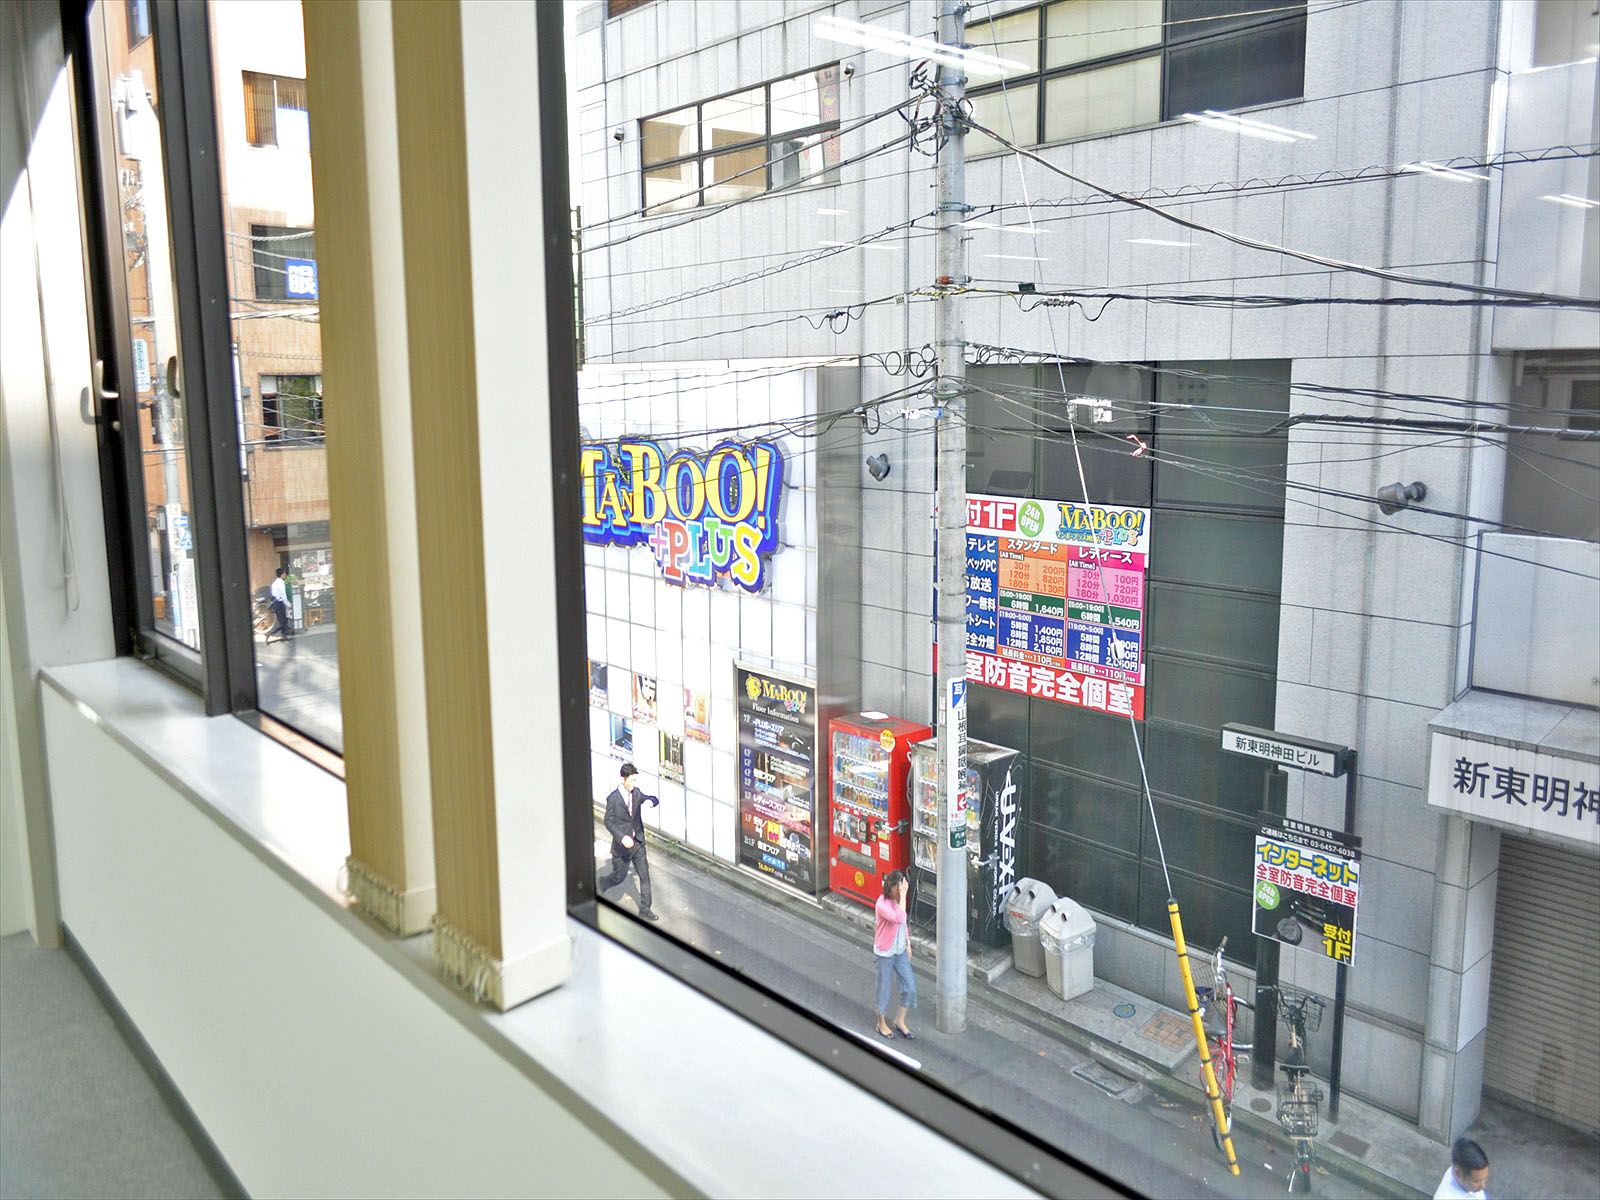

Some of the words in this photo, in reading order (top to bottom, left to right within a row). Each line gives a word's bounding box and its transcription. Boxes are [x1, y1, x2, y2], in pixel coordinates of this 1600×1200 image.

[1023, 503, 1041, 520] 24h
[1020, 514, 1040, 534] OPEN
[967, 537, 997, 554] テレビ
[1007, 538, 1058, 555] スタンダード
[1078, 546, 1133, 564] レディース
[1009, 570, 1030, 580] 120分
[1042, 574, 1065, 586] 820円
[1014, 561, 1030, 572] 30分
[1042, 565, 1065, 577] 200円
[1082, 570, 1099, 580] 30分
[1114, 574, 1139, 586] 100円
[1009, 578, 1029, 589] 180分
[1077, 579, 1099, 590] 120分
[1114, 584, 1138, 596] 720円
[1076, 588, 1099, 600] 180分
[1011, 599, 1029, 611] 6時間
[1034, 603, 1064, 617] 1,640円
[1081, 611, 1100, 623] 6時間
[1010, 620, 1029, 632] 5時間
[1034, 624, 1063, 638] 1,400円
[1006, 637, 1028, 650] 12時間
[1033, 643, 1063, 657] 2,160円
[1010, 629, 1028, 641] 8時間
[1034, 633, 1063, 648] 1,850円
[1080, 633, 1100, 645] 5時間
[1075, 650, 1099, 664] 12時間
[1080, 642, 1099, 655] 8時間
[752, 702, 767, 713] Floor
[767, 706, 800, 724] Information
[1235, 736, 1320, 766] 新東明神田ビル
[1282, 819, 1334, 840] 新東明株式会社
[1310, 840, 1356, 859] 03-6457-6038
[1257, 841, 1358, 886] インターネット
[1256, 863, 1357, 908] 全室防音完全個室
[1323, 922, 1352, 944] 受付
[1322, 939, 1352, 960] 1F
